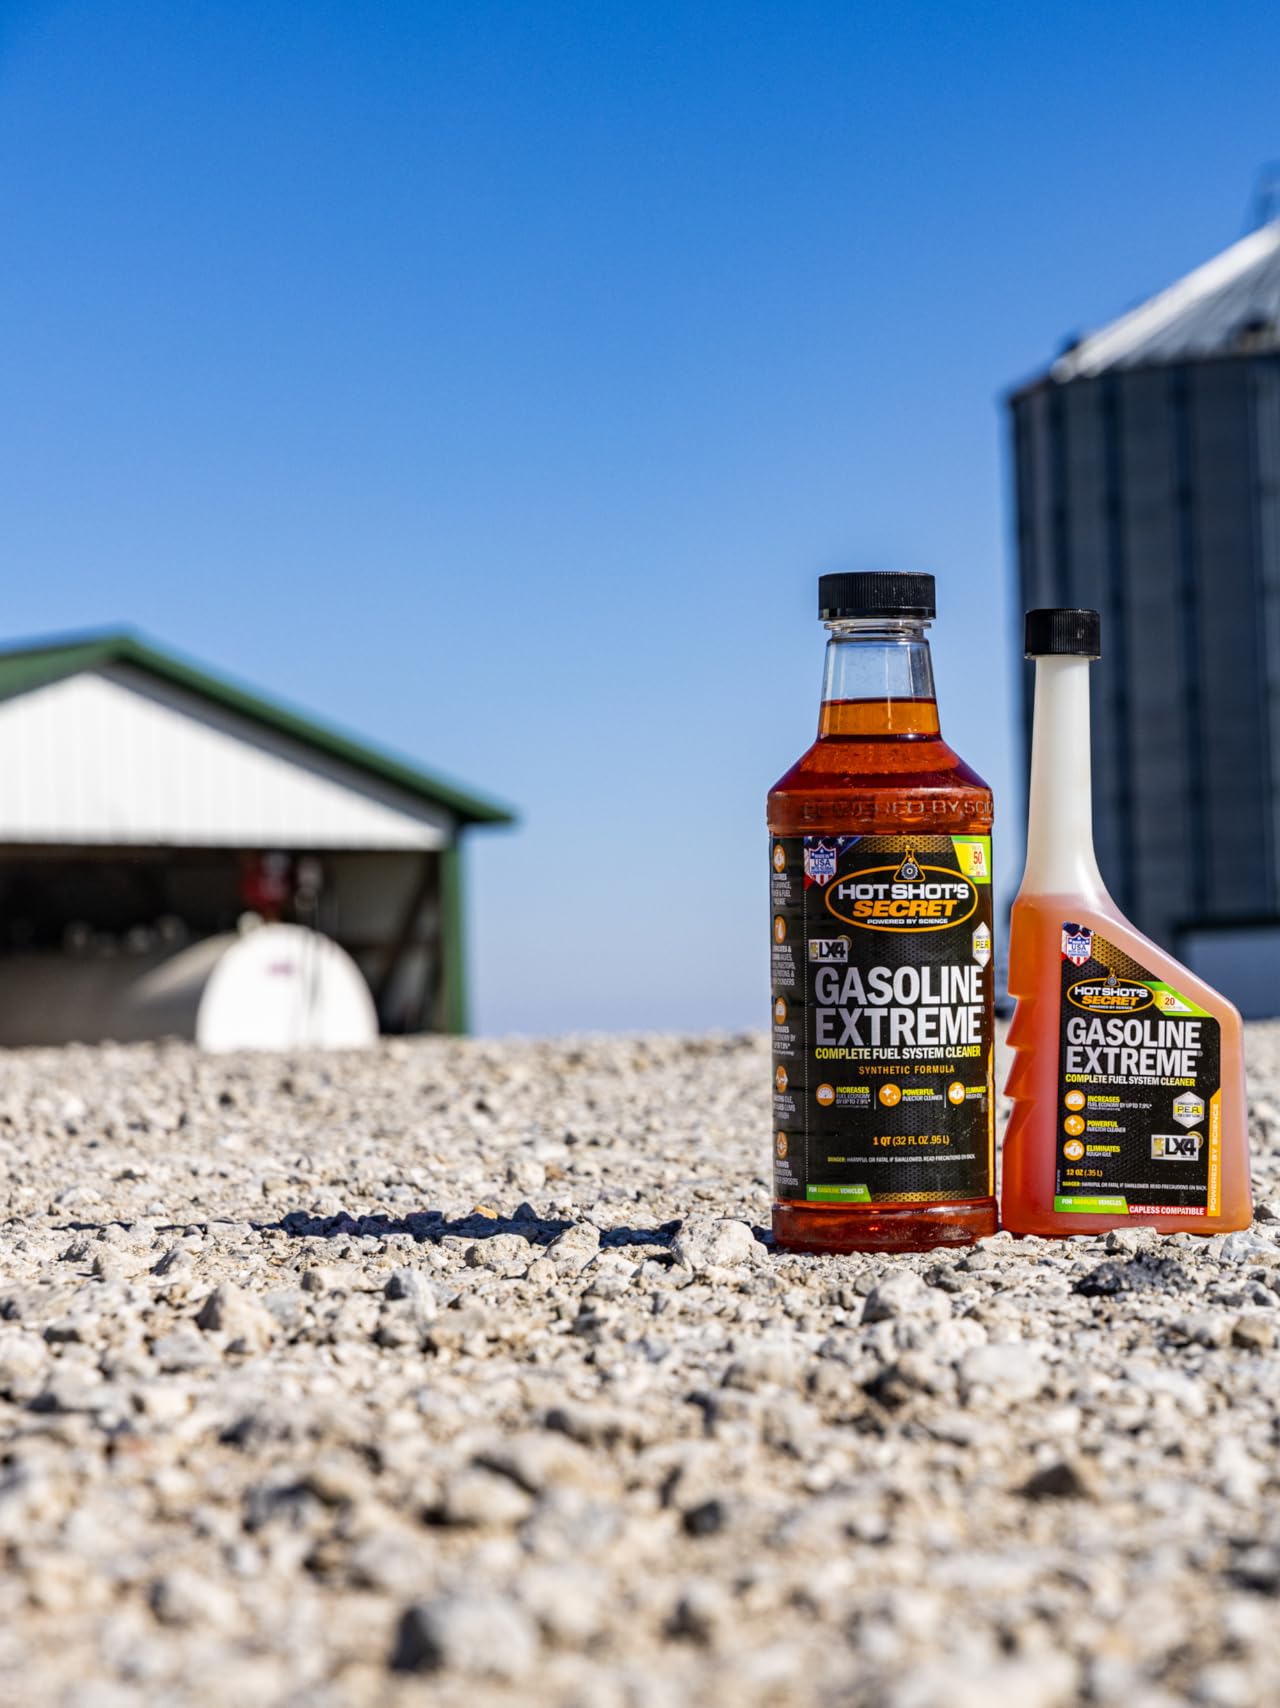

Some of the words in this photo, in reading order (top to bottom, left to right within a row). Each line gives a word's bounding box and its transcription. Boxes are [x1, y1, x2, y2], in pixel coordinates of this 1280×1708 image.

[814, 859, 831, 867] USA
[973, 851, 983, 865] 50
[838, 884, 889, 900] HOT
[891, 883, 969, 900] SHOT'S
[852, 900, 958, 917] SECRET
[1071, 943, 1087, 951] USA
[815, 965, 984, 1005] GASOLINE
[1074, 986, 1101, 996] HOT
[1101, 987, 1149, 998] SHOT'S
[1081, 995, 1140, 1006] SECRET
[1164, 997, 1176, 1006] 20
[815, 1006, 982, 1046] EXTREME
[1066, 1017, 1202, 1049] GASOLINE
[815, 1047, 871, 1060] COMPLETE
[873, 1048, 900, 1060] FUEL
[902, 1047, 944, 1060] SYSTEM
[945, 1045, 981, 1058] CLEANER
[1066, 1046, 1198, 1078] EXTREME
[858, 1065, 911, 1075] SYNTHETIC
[914, 1064, 955, 1074] FORMULA
[1065, 1073, 1108, 1084] COMPLETE
[1108, 1075, 1128, 1085] FUEL
[1128, 1075, 1160, 1086] SYSTEM
[1160, 1077, 1196, 1088] CLEANER
[836, 1086, 870, 1094] INCREASES
[902, 1088, 935, 1096] POWERFUL
[1087, 1095, 1120, 1103] INCREASES
[1087, 1119, 1118, 1128] POWERFUL
[873, 1136, 879, 1145] 1
[880, 1136, 892, 1146] QT
[908, 1136, 917, 1145] FL
[918, 1136, 929, 1145] OZ
[1165, 1137, 1197, 1156] LX4
[1086, 1145, 1121, 1153] ELIMINATES
[1211, 1148, 1217, 1161] BY
[1066, 1168, 1075, 1176] 12
[1075, 1168, 1084, 1176] OZ
[1129, 1205, 1160, 1214] CAPLESS
[1160, 1206, 1204, 1216] COMPATIBLE
